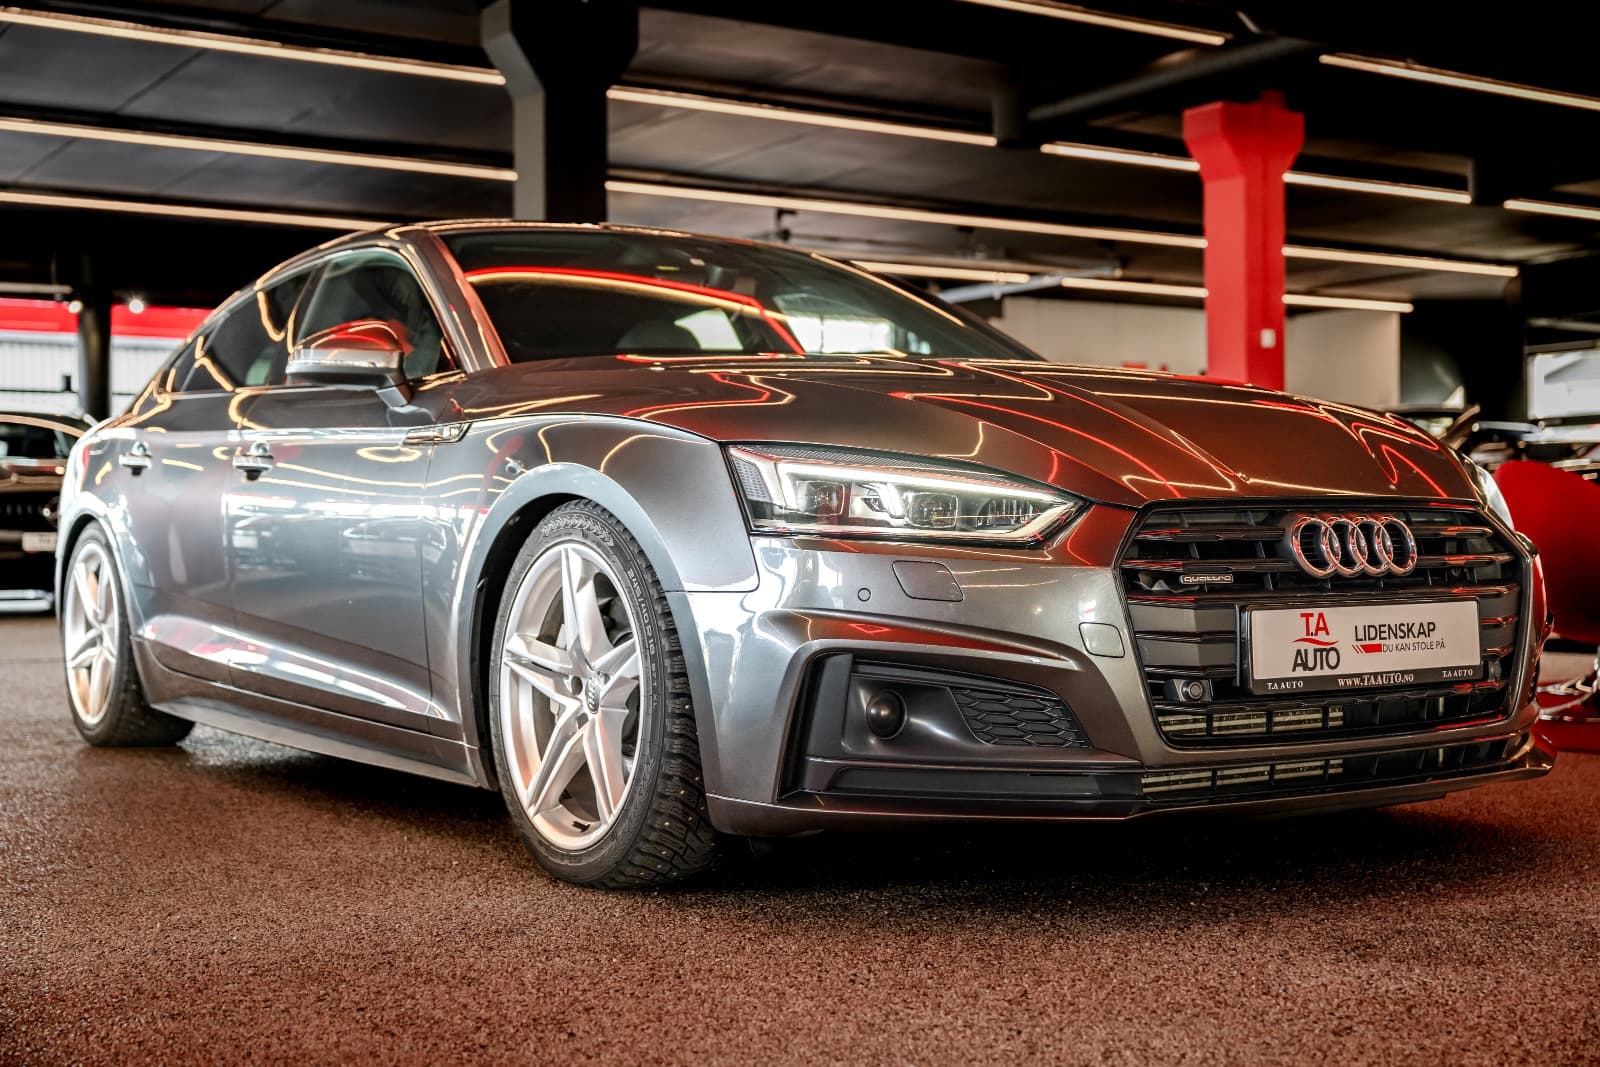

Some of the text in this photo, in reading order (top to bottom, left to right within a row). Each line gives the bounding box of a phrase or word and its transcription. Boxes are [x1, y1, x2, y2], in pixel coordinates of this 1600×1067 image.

[1184, 575, 1232, 583] quattro
[1300, 612, 1329, 636] T.A
[1354, 621, 1435, 642] LIDENSKAP
[1382, 638, 1446, 653] DU KAN STOLE PÅ
[1292, 647, 1340, 672] AUTO
[1453, 669, 1473, 677] AUTO
[1280, 680, 1304, 689] AUTO
